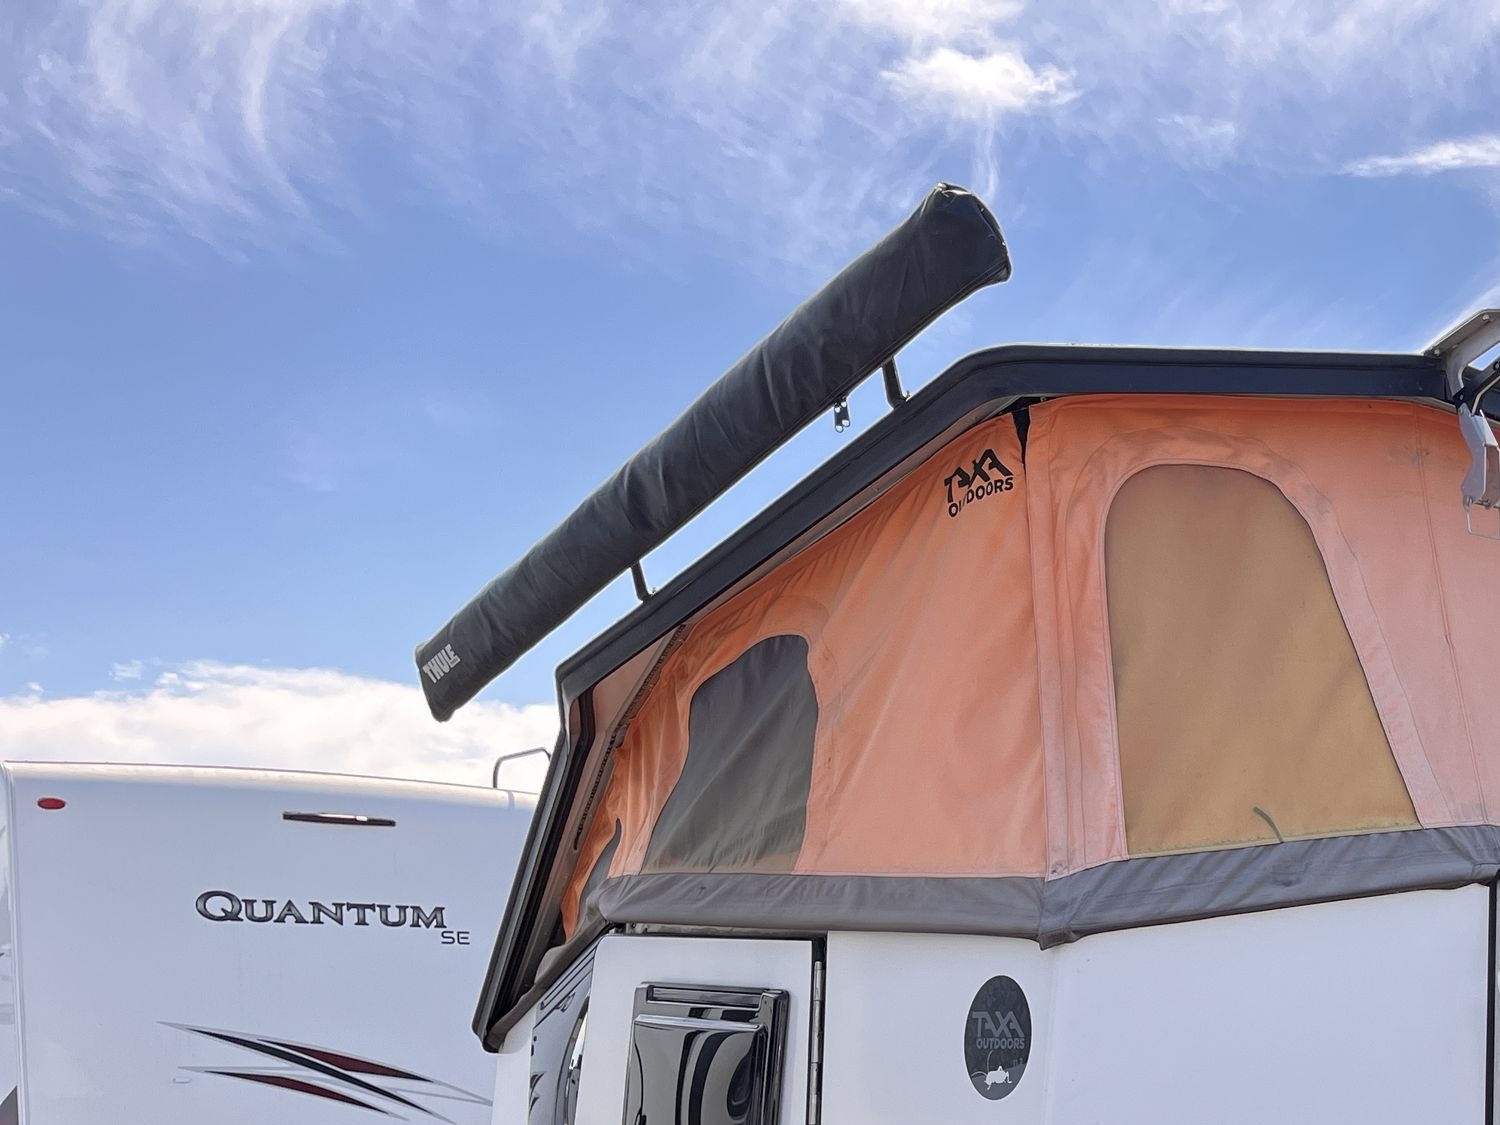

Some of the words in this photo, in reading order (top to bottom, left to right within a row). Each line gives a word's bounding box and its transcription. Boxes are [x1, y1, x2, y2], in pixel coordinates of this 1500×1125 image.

[944, 449, 1013, 503] TAXA
[948, 477, 1013, 517] ODOORS
[422, 643, 460, 684] THULE
[195, 890, 447, 929] QUANTUM
[441, 931, 471, 945] SE
[972, 1010, 1026, 1038] TAXA
[976, 1037, 1026, 1050] OUTDOORS
